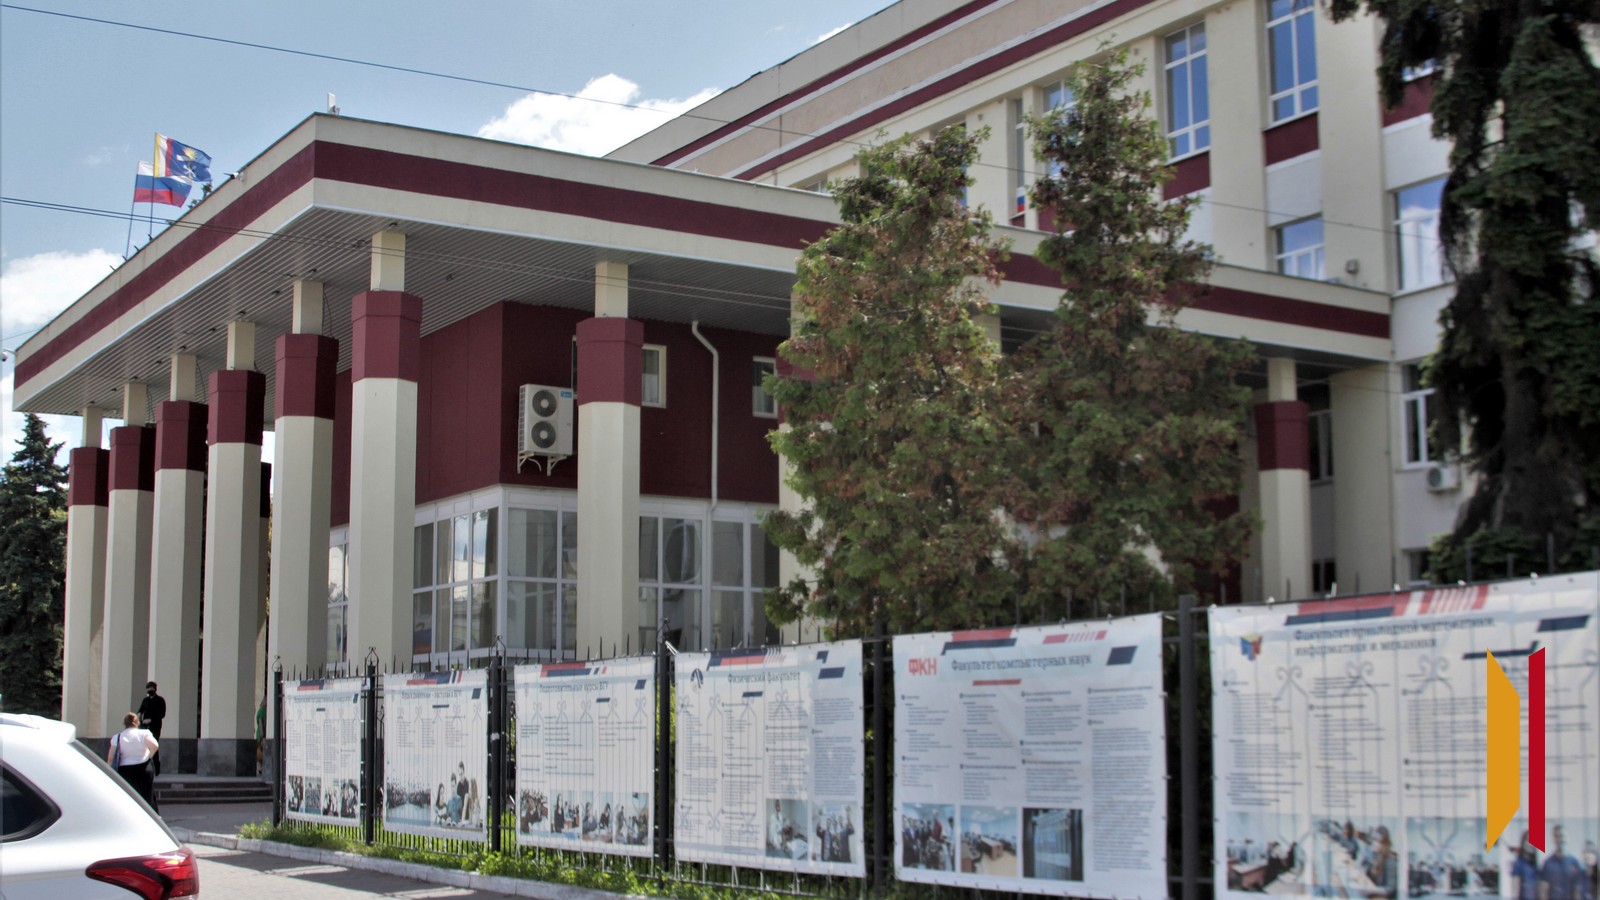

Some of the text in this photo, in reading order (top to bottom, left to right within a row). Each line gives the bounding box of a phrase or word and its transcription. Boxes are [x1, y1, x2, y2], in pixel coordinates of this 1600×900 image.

[1295, 629, 1350, 641] Факультет
[908, 657, 937, 676] ФКН
[1068, 654, 1092, 668] наук
